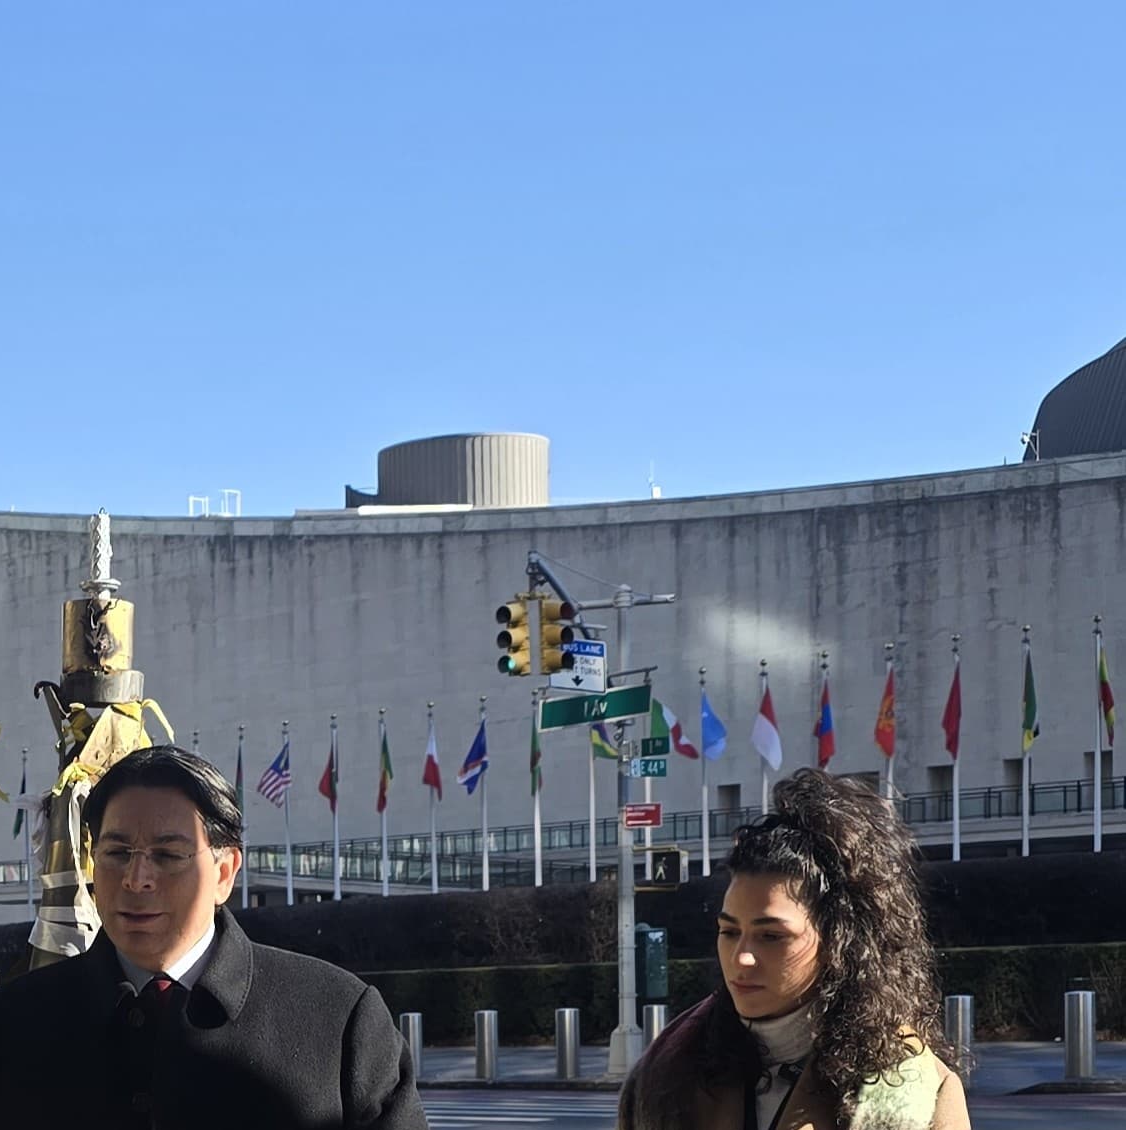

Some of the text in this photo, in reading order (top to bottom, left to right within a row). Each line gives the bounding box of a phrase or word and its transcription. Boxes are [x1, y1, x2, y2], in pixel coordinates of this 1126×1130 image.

[580, 644, 603, 655] LANE
[592, 700, 608, 716] Av
[641, 761, 646, 775] E
[647, 761, 658, 775] 44
